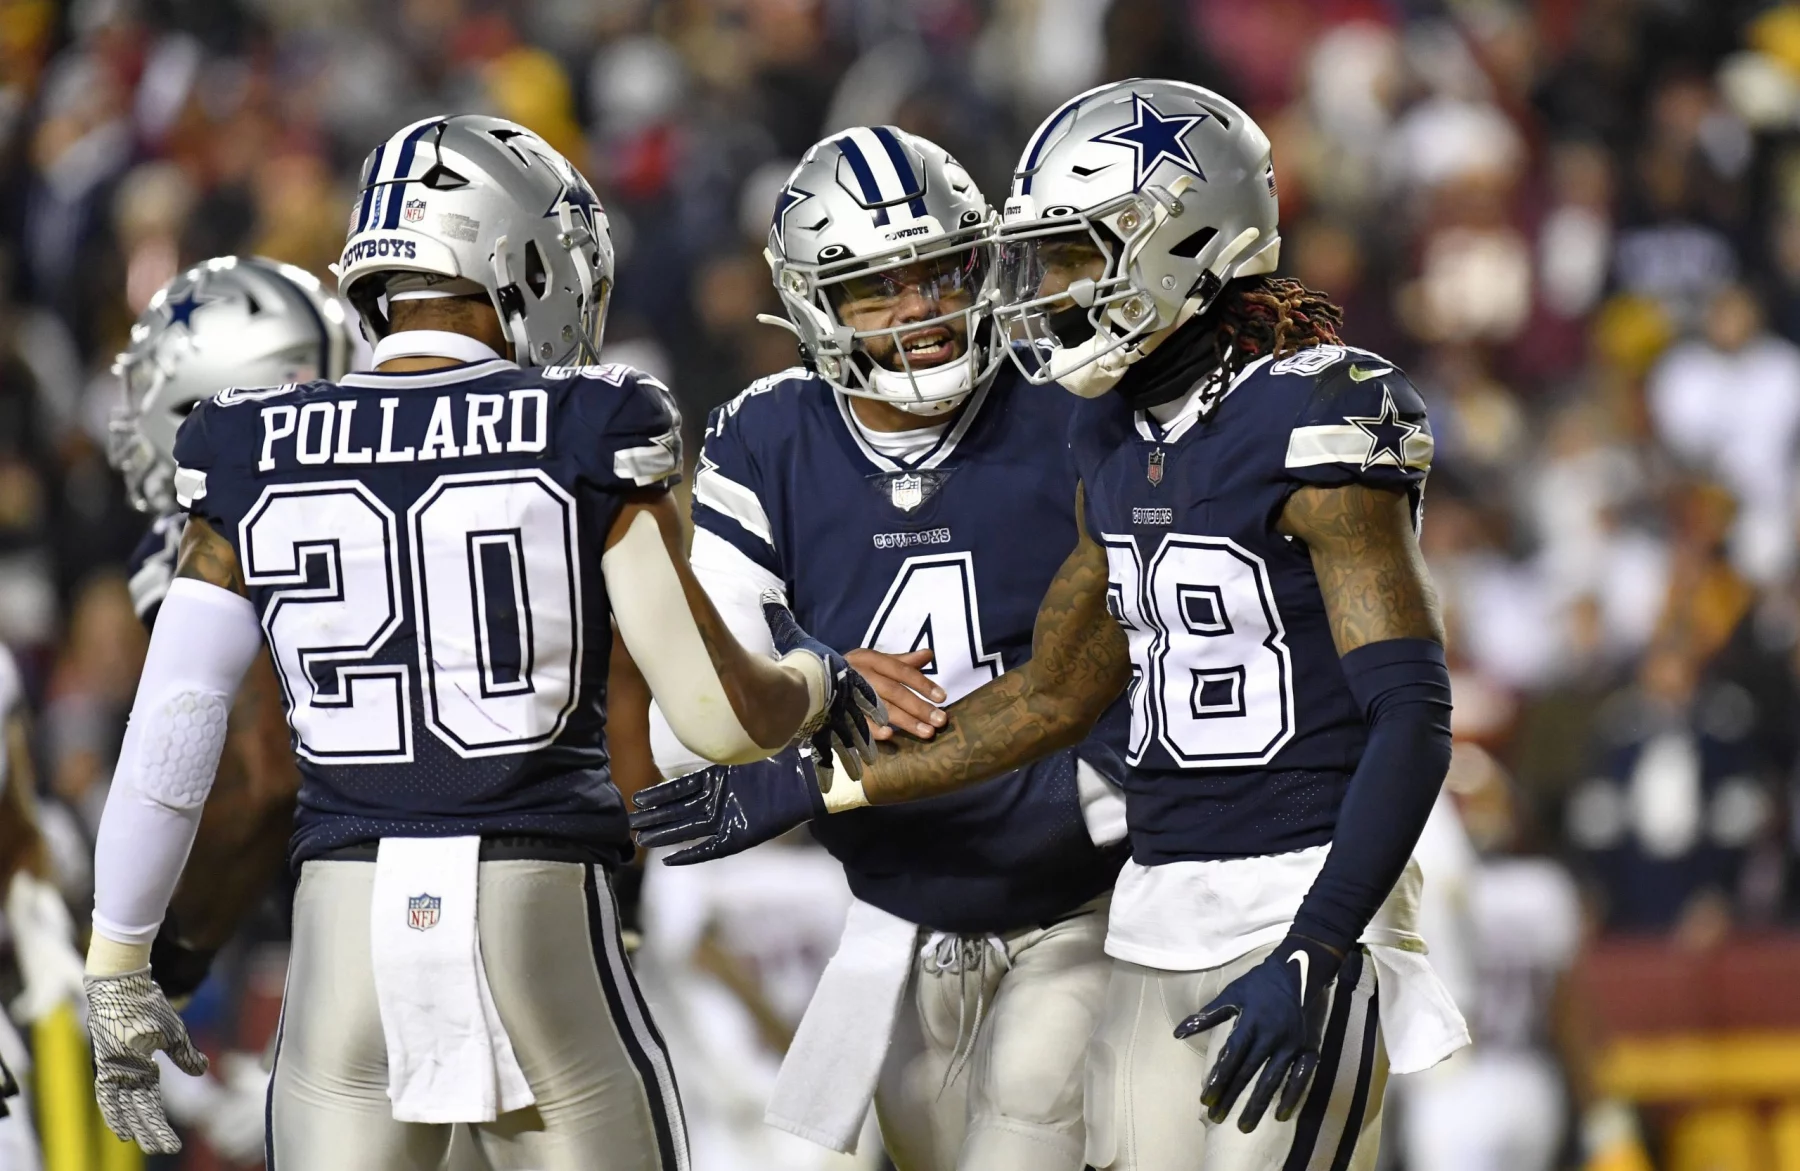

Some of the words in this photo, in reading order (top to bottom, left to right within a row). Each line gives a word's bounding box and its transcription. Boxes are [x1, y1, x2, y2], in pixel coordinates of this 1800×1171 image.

[405, 208, 423, 221] NFL
[343, 238, 416, 272] COWBOYS
[258, 389, 547, 472] POLLARD
[1132, 507, 1172, 524] COWBOYS
[873, 527, 951, 549] COWBOYS
[238, 468, 583, 764] 20
[860, 551, 1004, 707] 4
[411, 910, 437, 927] NFL
